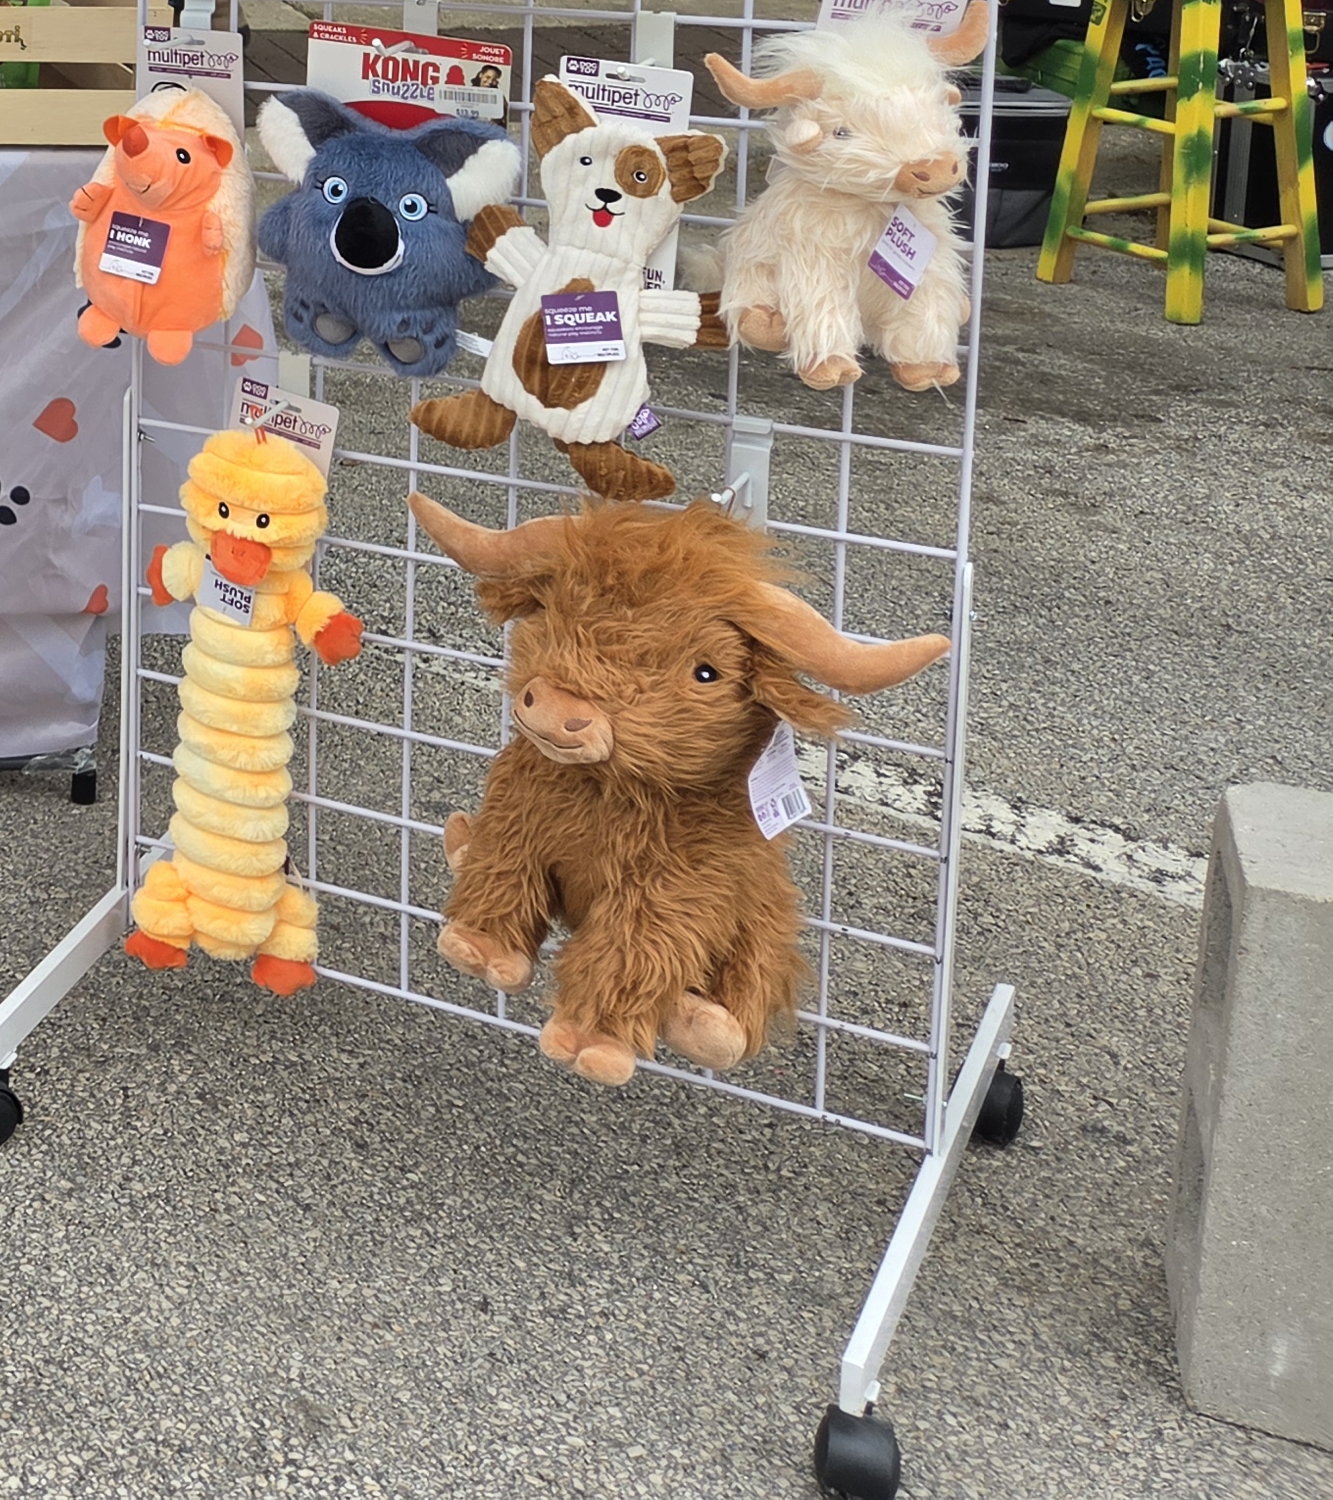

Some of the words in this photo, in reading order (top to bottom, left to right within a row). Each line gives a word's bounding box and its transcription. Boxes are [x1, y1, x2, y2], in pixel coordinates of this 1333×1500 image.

[314, 24, 347, 34] SQUEAKS
[320, 33, 357, 43] CRACKLES
[148, 49, 204, 67] multipet
[472, 53, 504, 64] SONORE
[479, 46, 505, 56] JOUET
[362, 52, 441, 88] KONG
[568, 83, 640, 106] multipet
[890, 216, 915, 242] SOFT
[109, 229, 115, 239] I
[116, 231, 152, 249] HONK
[885, 227, 916, 260] PLUSH
[544, 307, 577, 315] squeeze
[545, 315, 551, 325] I
[554, 311, 618, 326] SQUEAK
[214, 579, 251, 604] PLUSH
[220, 593, 251, 614] SOFT
